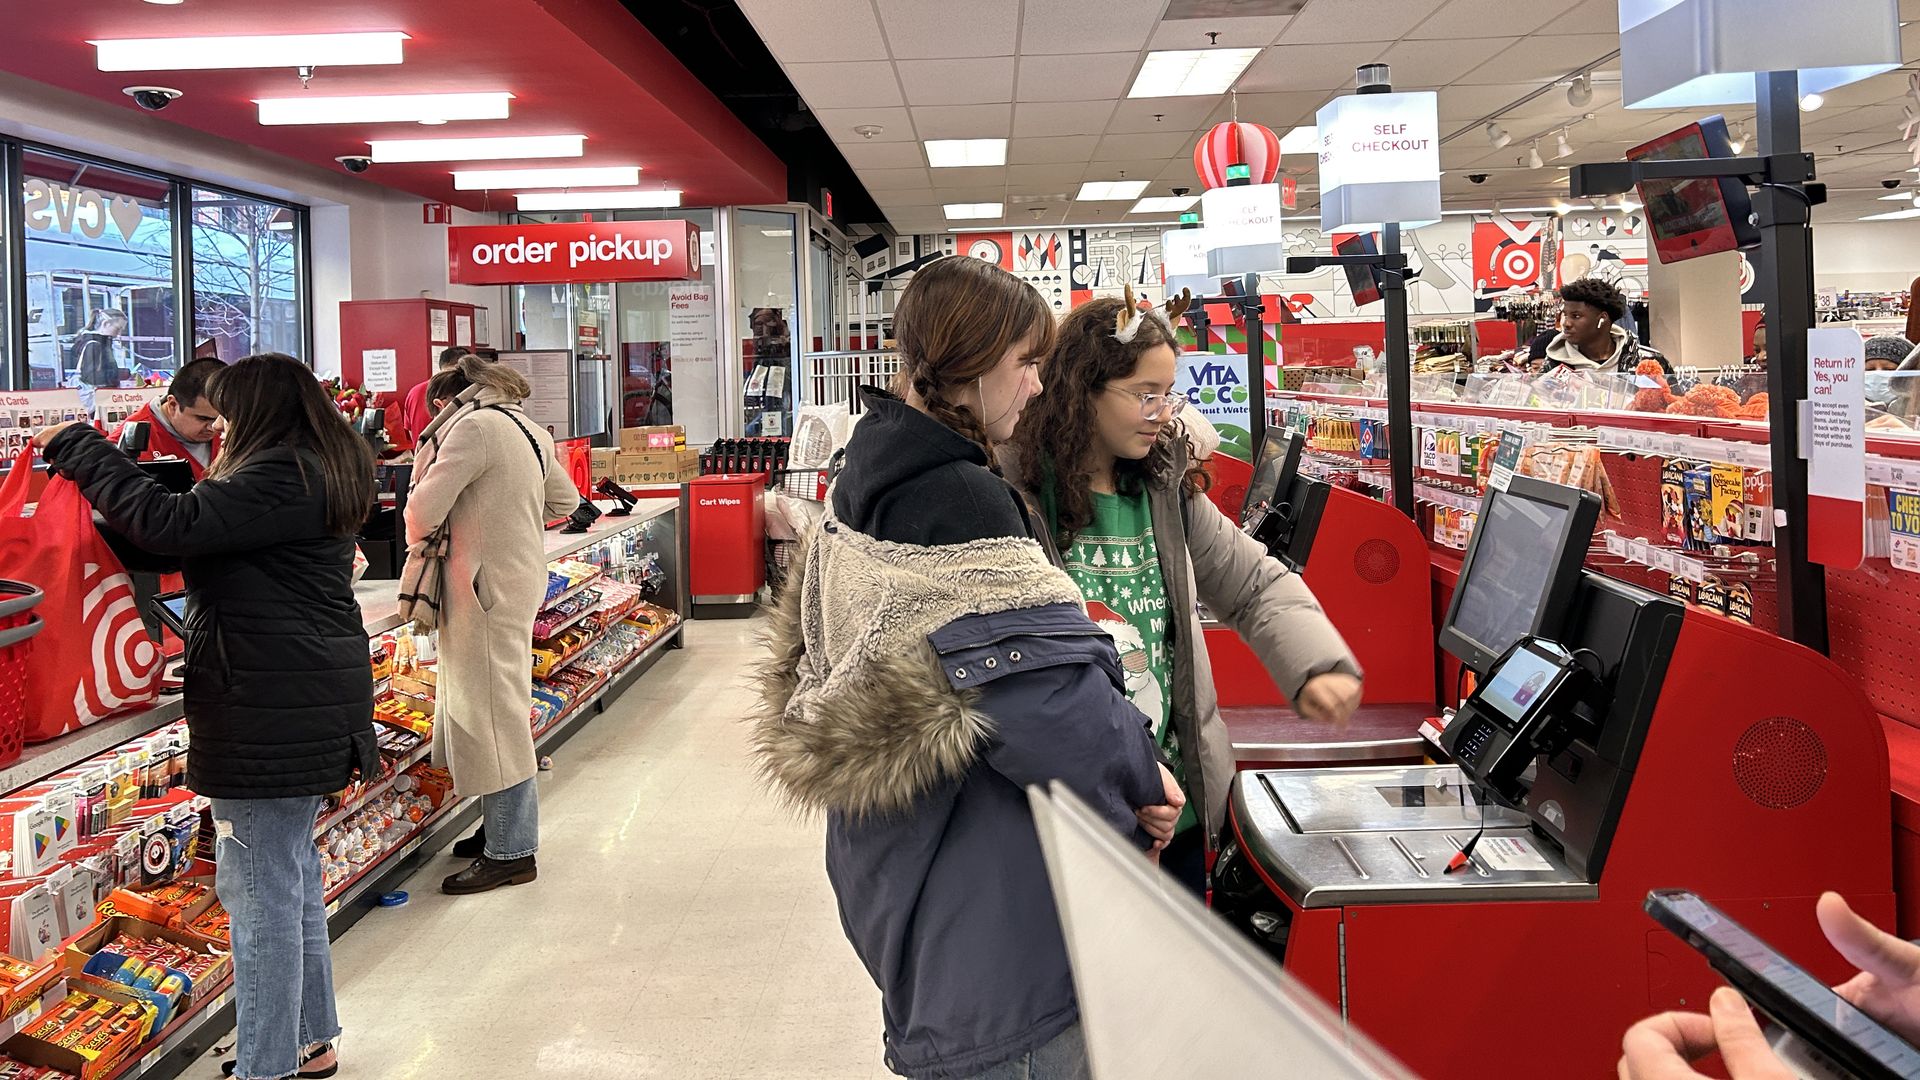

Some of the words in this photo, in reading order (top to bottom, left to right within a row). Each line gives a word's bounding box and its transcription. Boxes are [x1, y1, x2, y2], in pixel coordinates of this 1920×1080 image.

[1374, 124, 1407, 135] SELF
[1352, 139, 1429, 152] CHECKOUT
[472, 236, 557, 265] order
[569, 233, 673, 268] pickup
[693, 294, 709, 302] Bag
[671, 302, 689, 310] Fees
[1814, 357, 1842, 368] Return
[1844, 357, 1856, 368] it?
[1188, 362, 1240, 386] VITA
[1814, 371, 1831, 383] Yes,
[1832, 373, 1848, 384] you
[1814, 384, 1832, 395] can!
[7, 397, 29, 406] Cards
[111, 394, 124, 403] Gift
[124, 393, 143, 402] Cards
[1424, 451, 1435, 459] TACO
[1662, 471, 1683, 483] LORCANA
[1720, 484, 1741, 499] Factory
[718, 498, 741, 506] Wipes
[1891, 512, 1903, 531] TO
[1669, 581, 1691, 597] LORCANA
[1698, 590, 1723, 606] LORCANA
[1729, 600, 1751, 618] LORCANA
